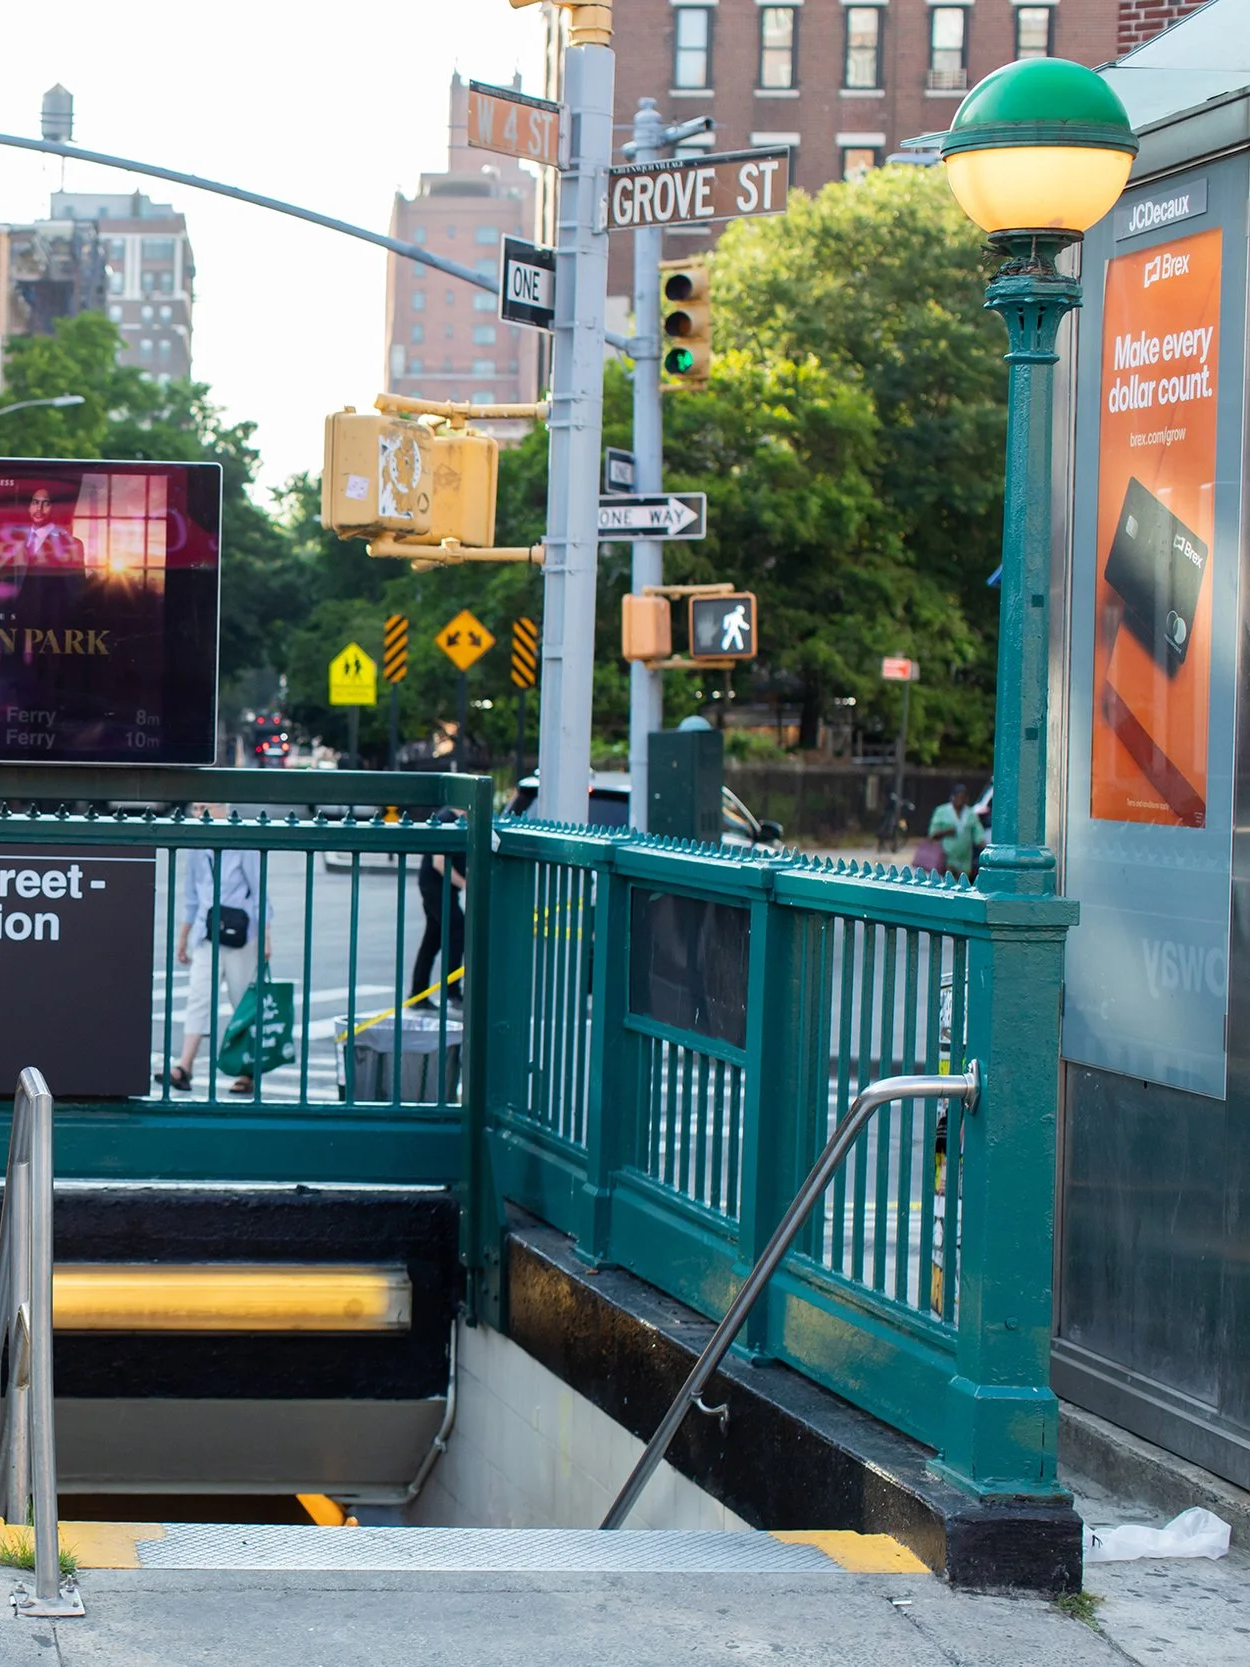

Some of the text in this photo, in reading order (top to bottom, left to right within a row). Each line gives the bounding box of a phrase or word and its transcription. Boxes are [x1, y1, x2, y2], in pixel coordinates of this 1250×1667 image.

[476, 95, 495, 145] W
[503, 105, 518, 151] 4
[528, 110, 553, 160] ST
[613, 161, 779, 225] GROVE ST
[1129, 195, 1190, 231] JCDecaux
[1161, 253, 1190, 279] Brex
[513, 266, 540, 301] ONE
[1114, 326, 1214, 371] Make every
[1109, 364, 1213, 413] dollar count.
[1130, 426, 1187, 447] brex.com/grow
[600, 509, 684, 526] ONE WAY
[1183, 541, 1203, 568] Brex
[23, 629, 110, 655] PARK
[6, 706, 56, 727] Ferry
[136, 710, 160, 726] 8m
[5, 729, 56, 748] Ferry
[125, 732, 160, 748] 10m
